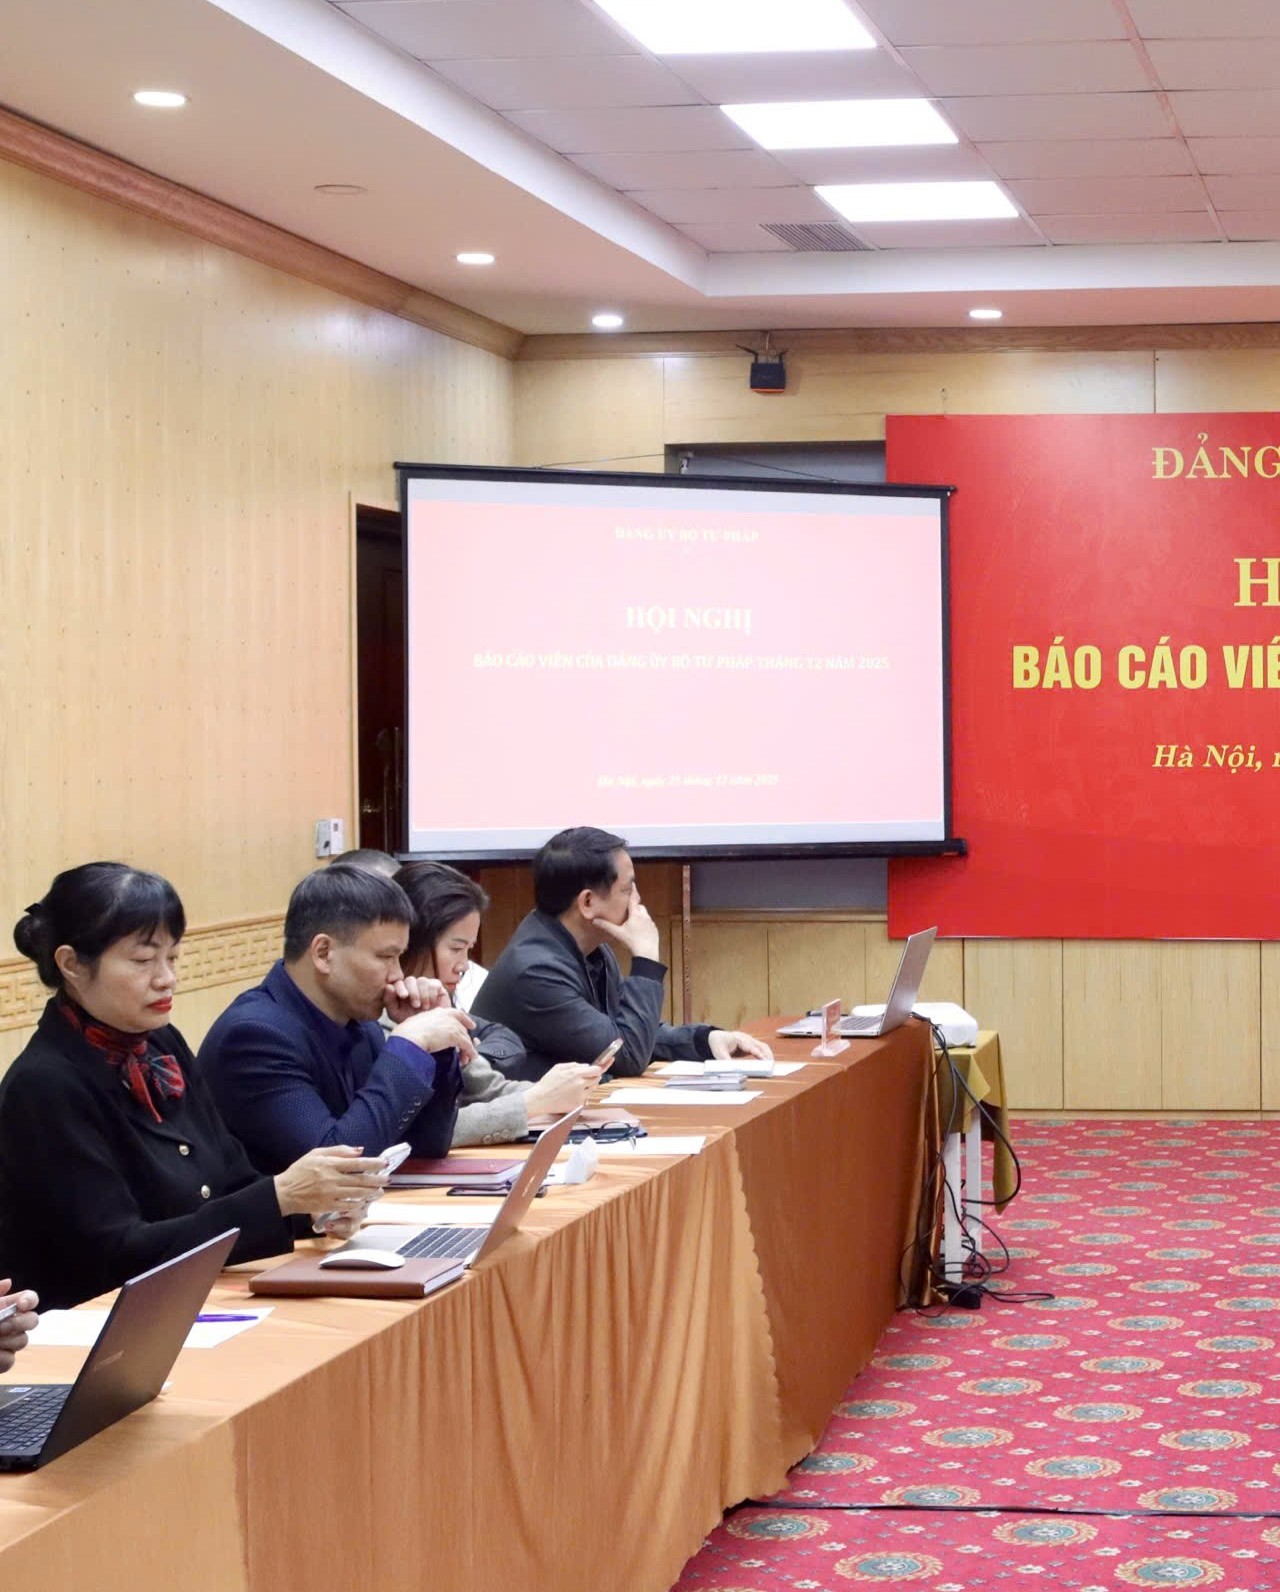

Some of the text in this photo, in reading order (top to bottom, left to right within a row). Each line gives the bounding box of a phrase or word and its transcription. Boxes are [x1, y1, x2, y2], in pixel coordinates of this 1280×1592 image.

[625, 604, 752, 635] HỘI NGHỊ
[857, 655, 890, 671] 2025
[1012, 635, 1102, 690] BÁO
[1117, 635, 1208, 690] CÁO
[1152, 744, 1194, 768] Hà
[1203, 744, 1264, 774] Nội,
